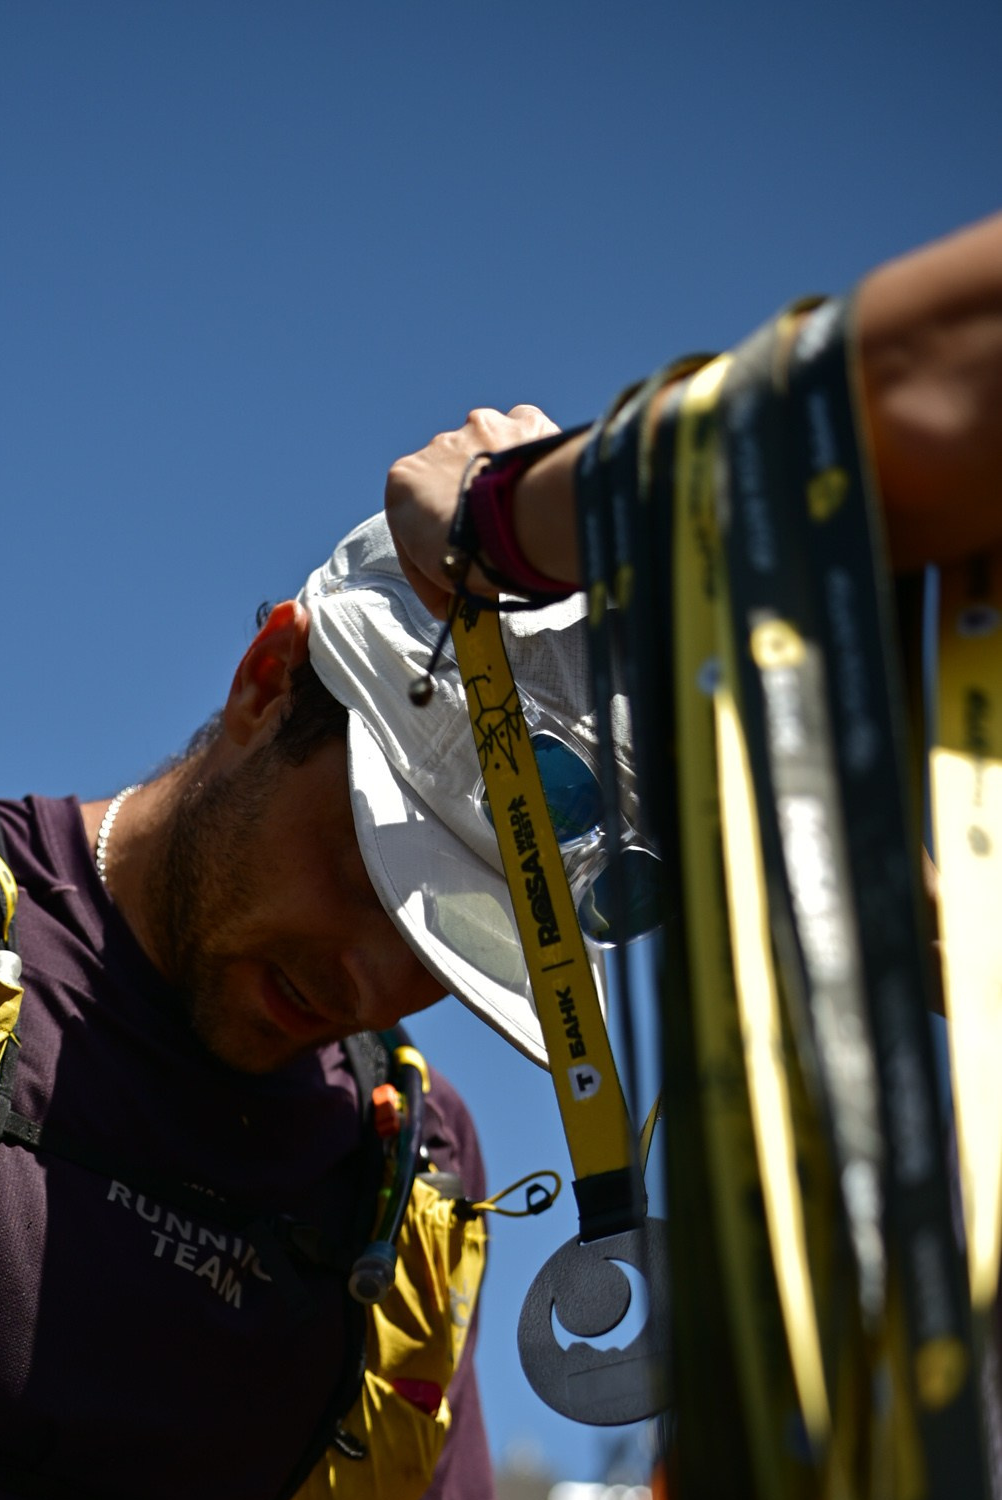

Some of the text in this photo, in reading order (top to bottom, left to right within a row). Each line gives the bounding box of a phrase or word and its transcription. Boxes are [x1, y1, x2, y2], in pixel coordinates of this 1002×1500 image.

[510, 813, 527, 856] WILD
[519, 811, 537, 850] FEST
[521, 850, 562, 948] ROSA
[555, 986, 586, 1060] БАНК
[151, 1230, 242, 1309] TEAM
